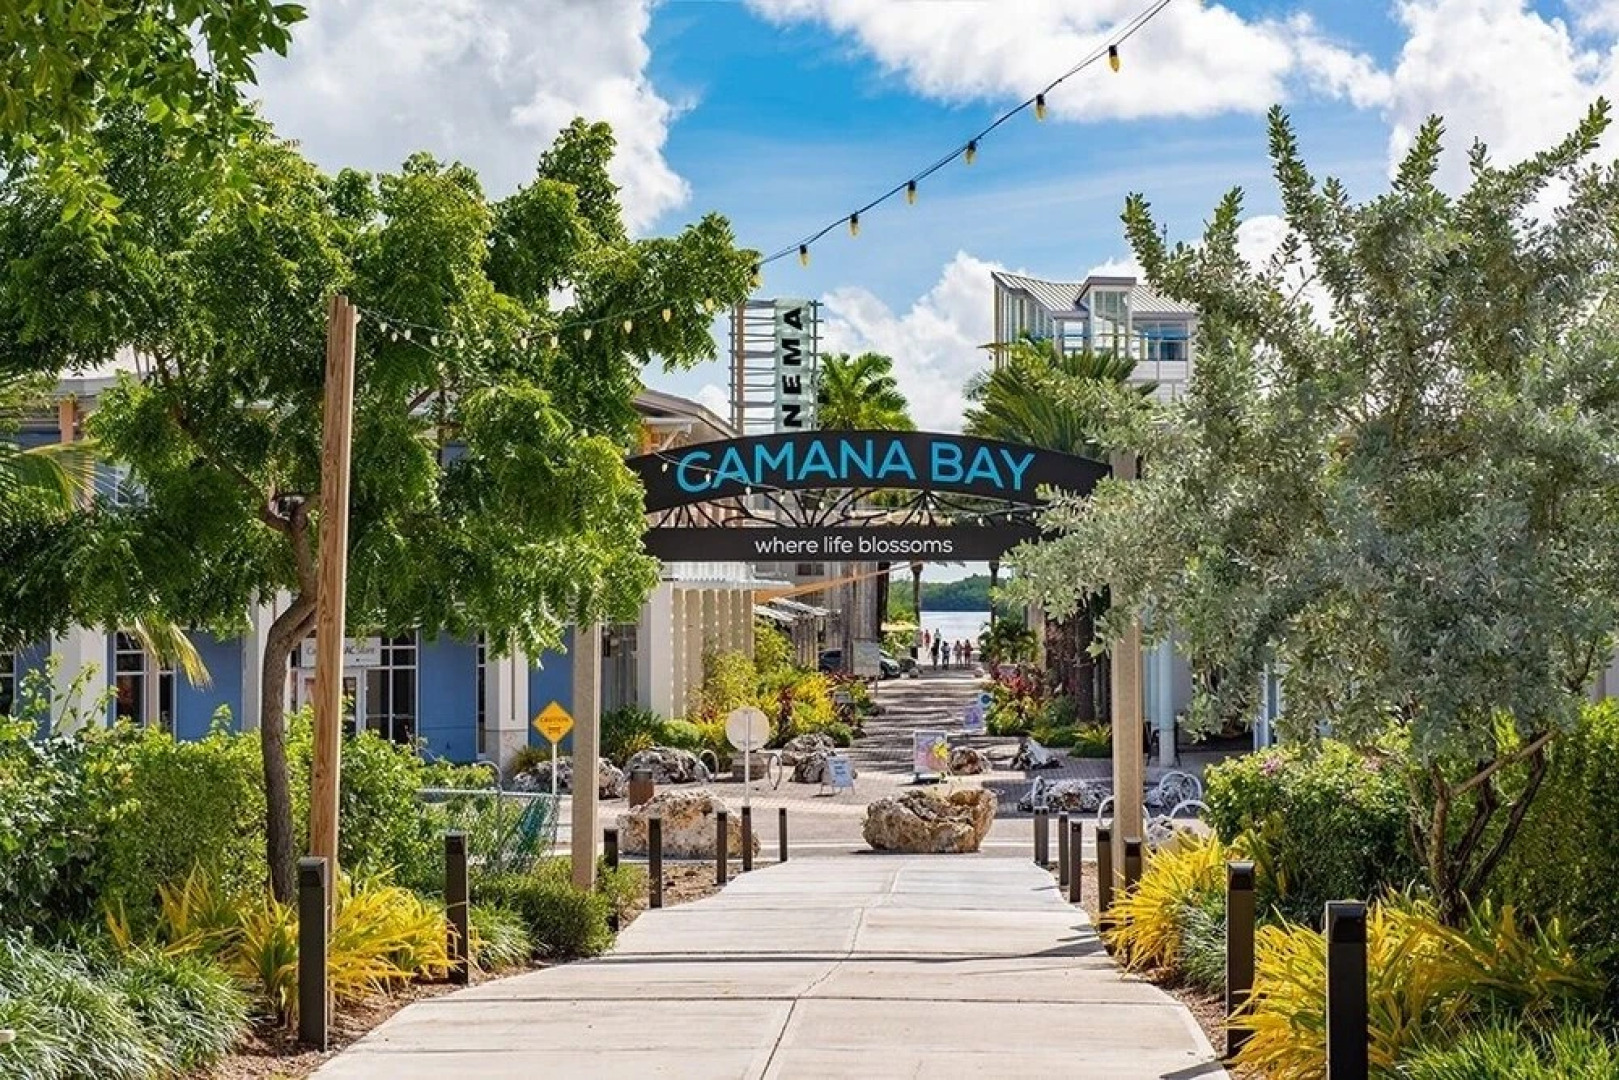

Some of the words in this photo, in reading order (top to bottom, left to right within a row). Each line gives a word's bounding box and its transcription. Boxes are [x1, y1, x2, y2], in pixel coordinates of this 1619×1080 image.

[781, 306, 803, 428] NEMA
[676, 439, 917, 493] CAMANA
[931, 441, 1036, 491] BAY
[754, 535, 819, 554] where
[823, 535, 854, 554] life
[858, 535, 953, 554] blossoms
